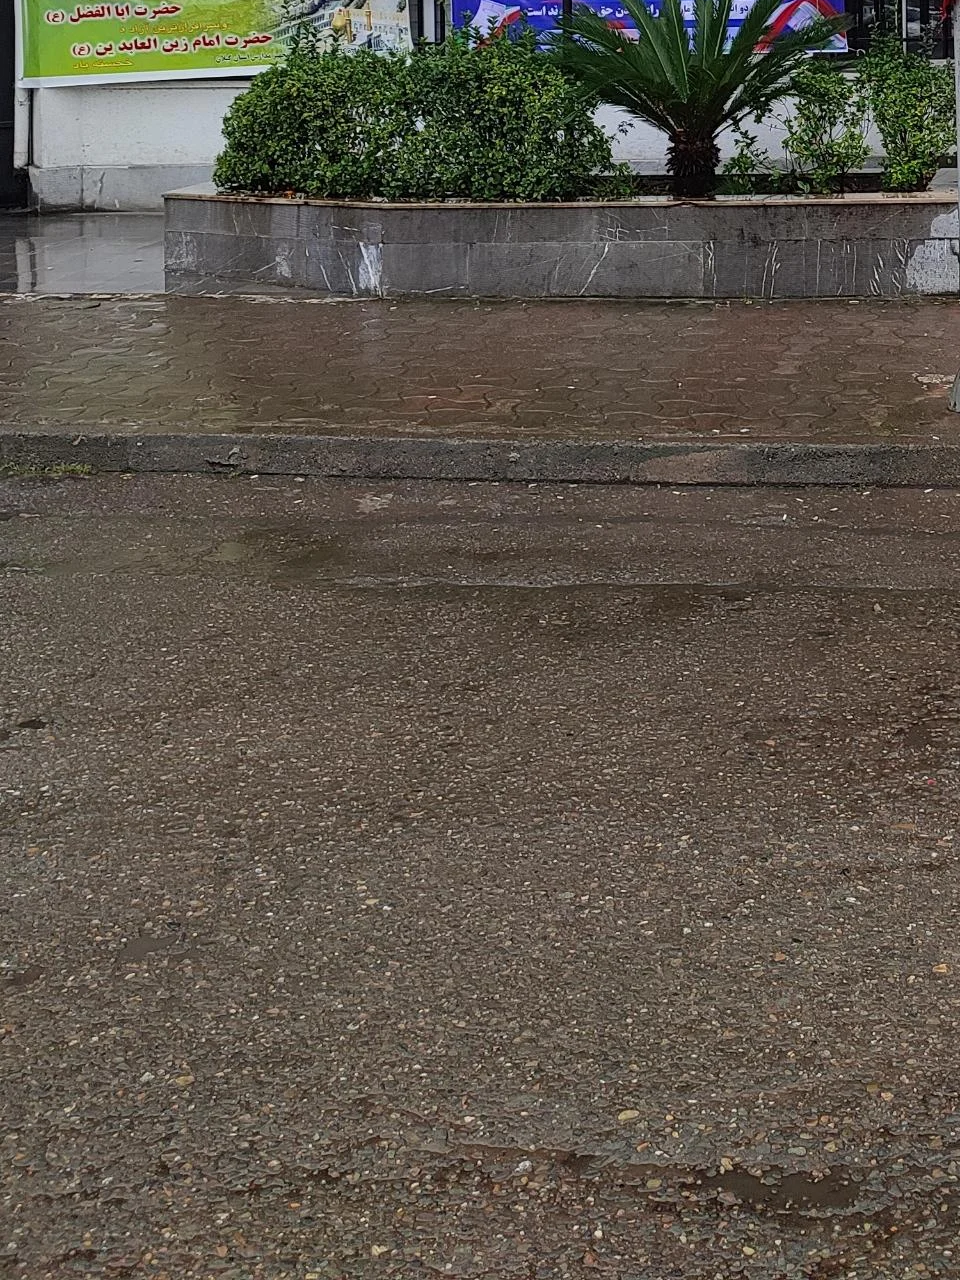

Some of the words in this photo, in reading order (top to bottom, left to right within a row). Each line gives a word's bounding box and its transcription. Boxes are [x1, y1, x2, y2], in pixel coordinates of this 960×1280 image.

[135, 1, 181, 20] حضرت
[162, 38, 188, 52] زین
[193, 34, 220, 51] امام
[225, 32, 272, 49] حضرت
